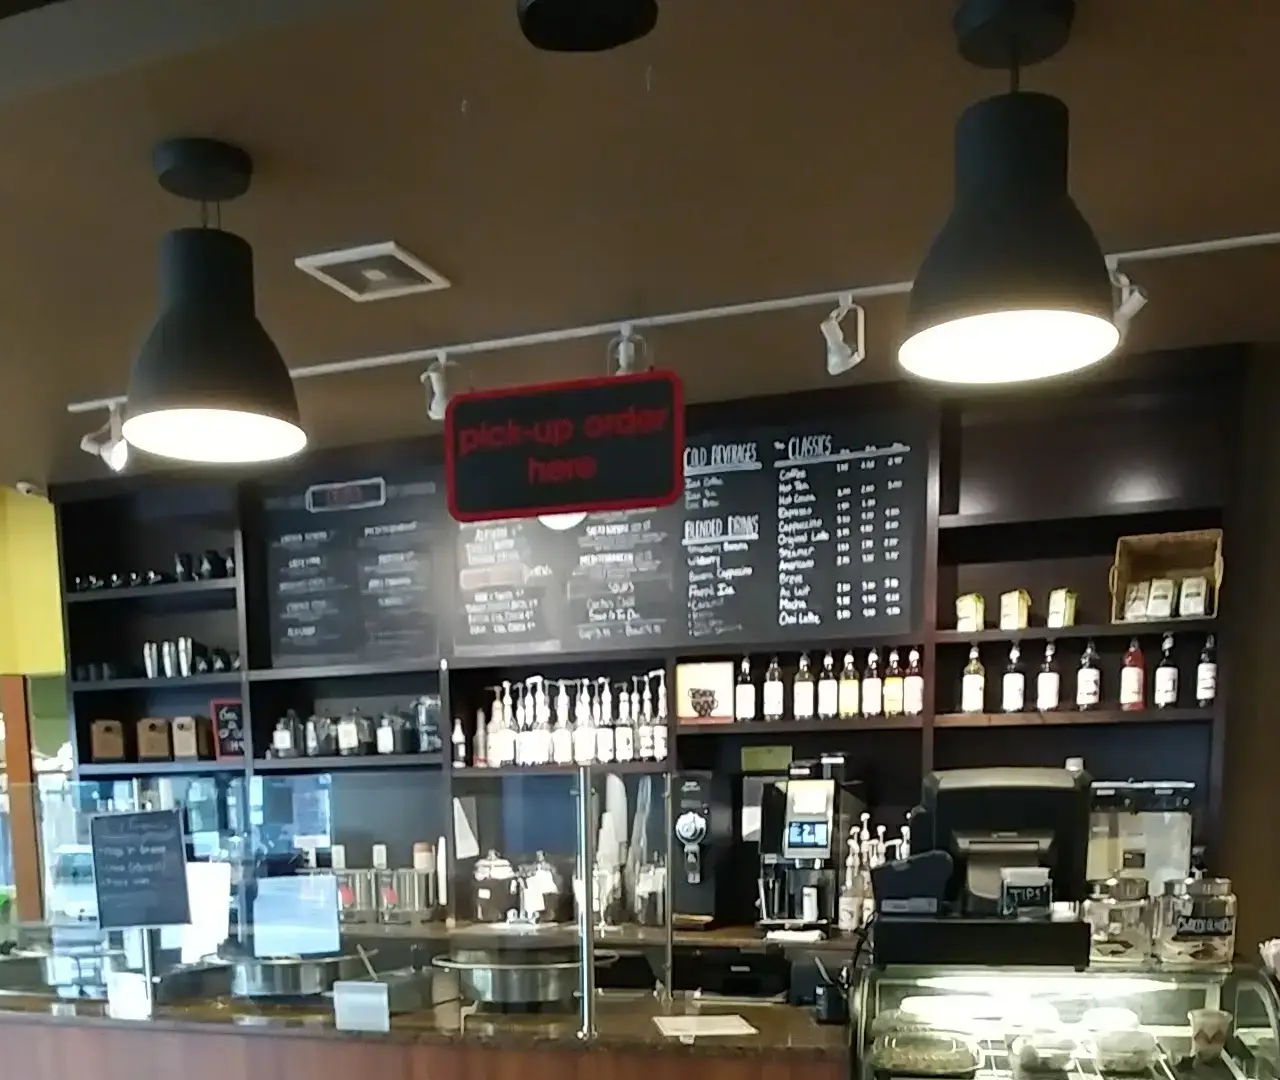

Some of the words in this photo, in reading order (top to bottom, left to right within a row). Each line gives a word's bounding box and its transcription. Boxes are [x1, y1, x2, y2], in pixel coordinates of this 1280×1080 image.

[459, 418, 574, 459] pick-up
[583, 405, 669, 438] order
[788, 435, 833, 460] CLASSICS
[528, 455, 597, 484] here
[684, 518, 723, 540] BLENDED
